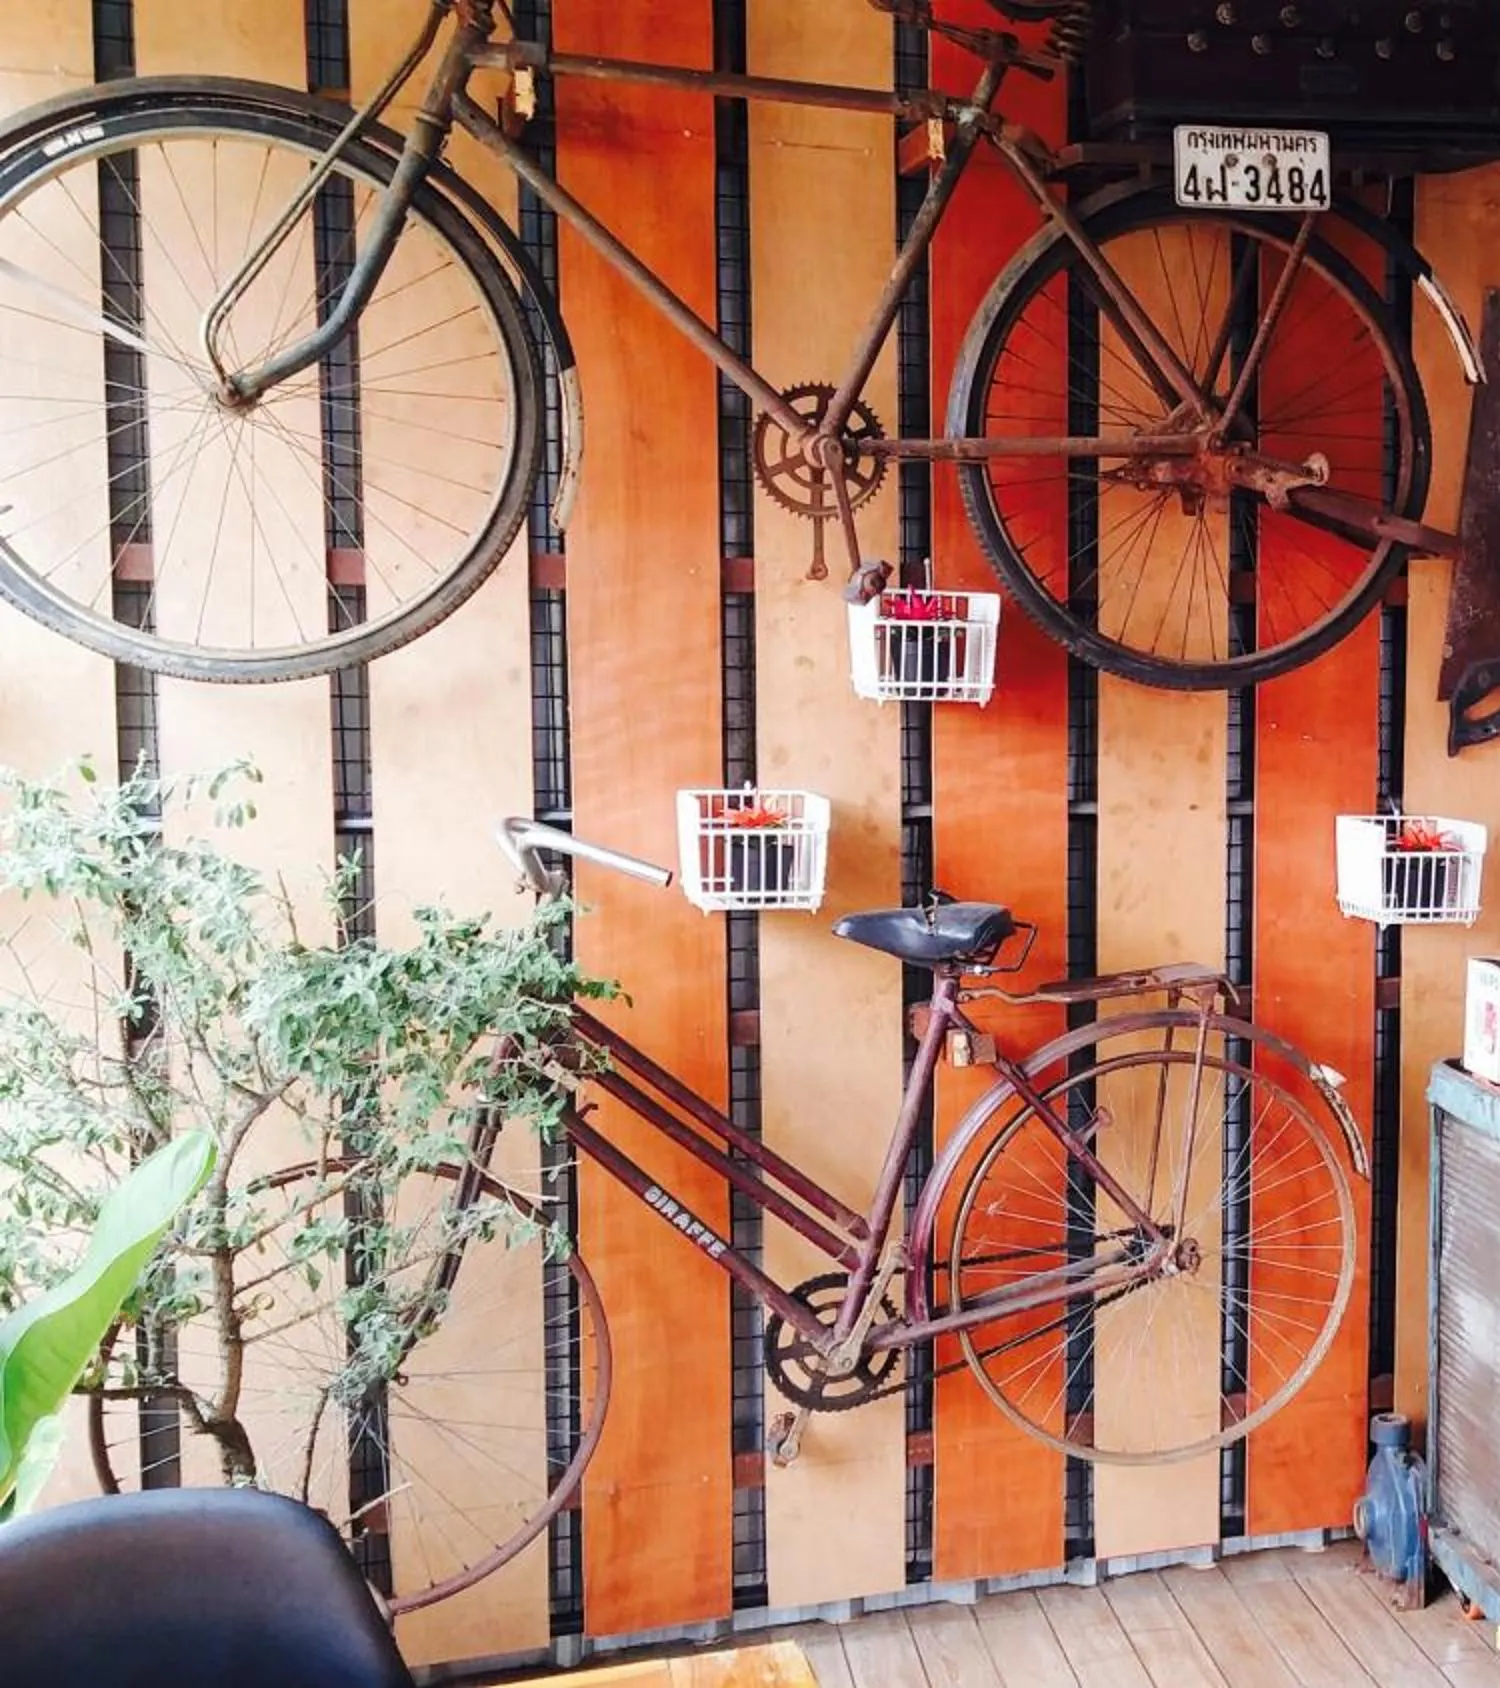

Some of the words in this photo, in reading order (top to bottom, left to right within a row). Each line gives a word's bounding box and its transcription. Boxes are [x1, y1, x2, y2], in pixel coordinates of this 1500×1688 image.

[1187, 131, 1317, 155] กรุงเทพมหานคร
[644, 1185, 727, 1258] GIRAFFE
